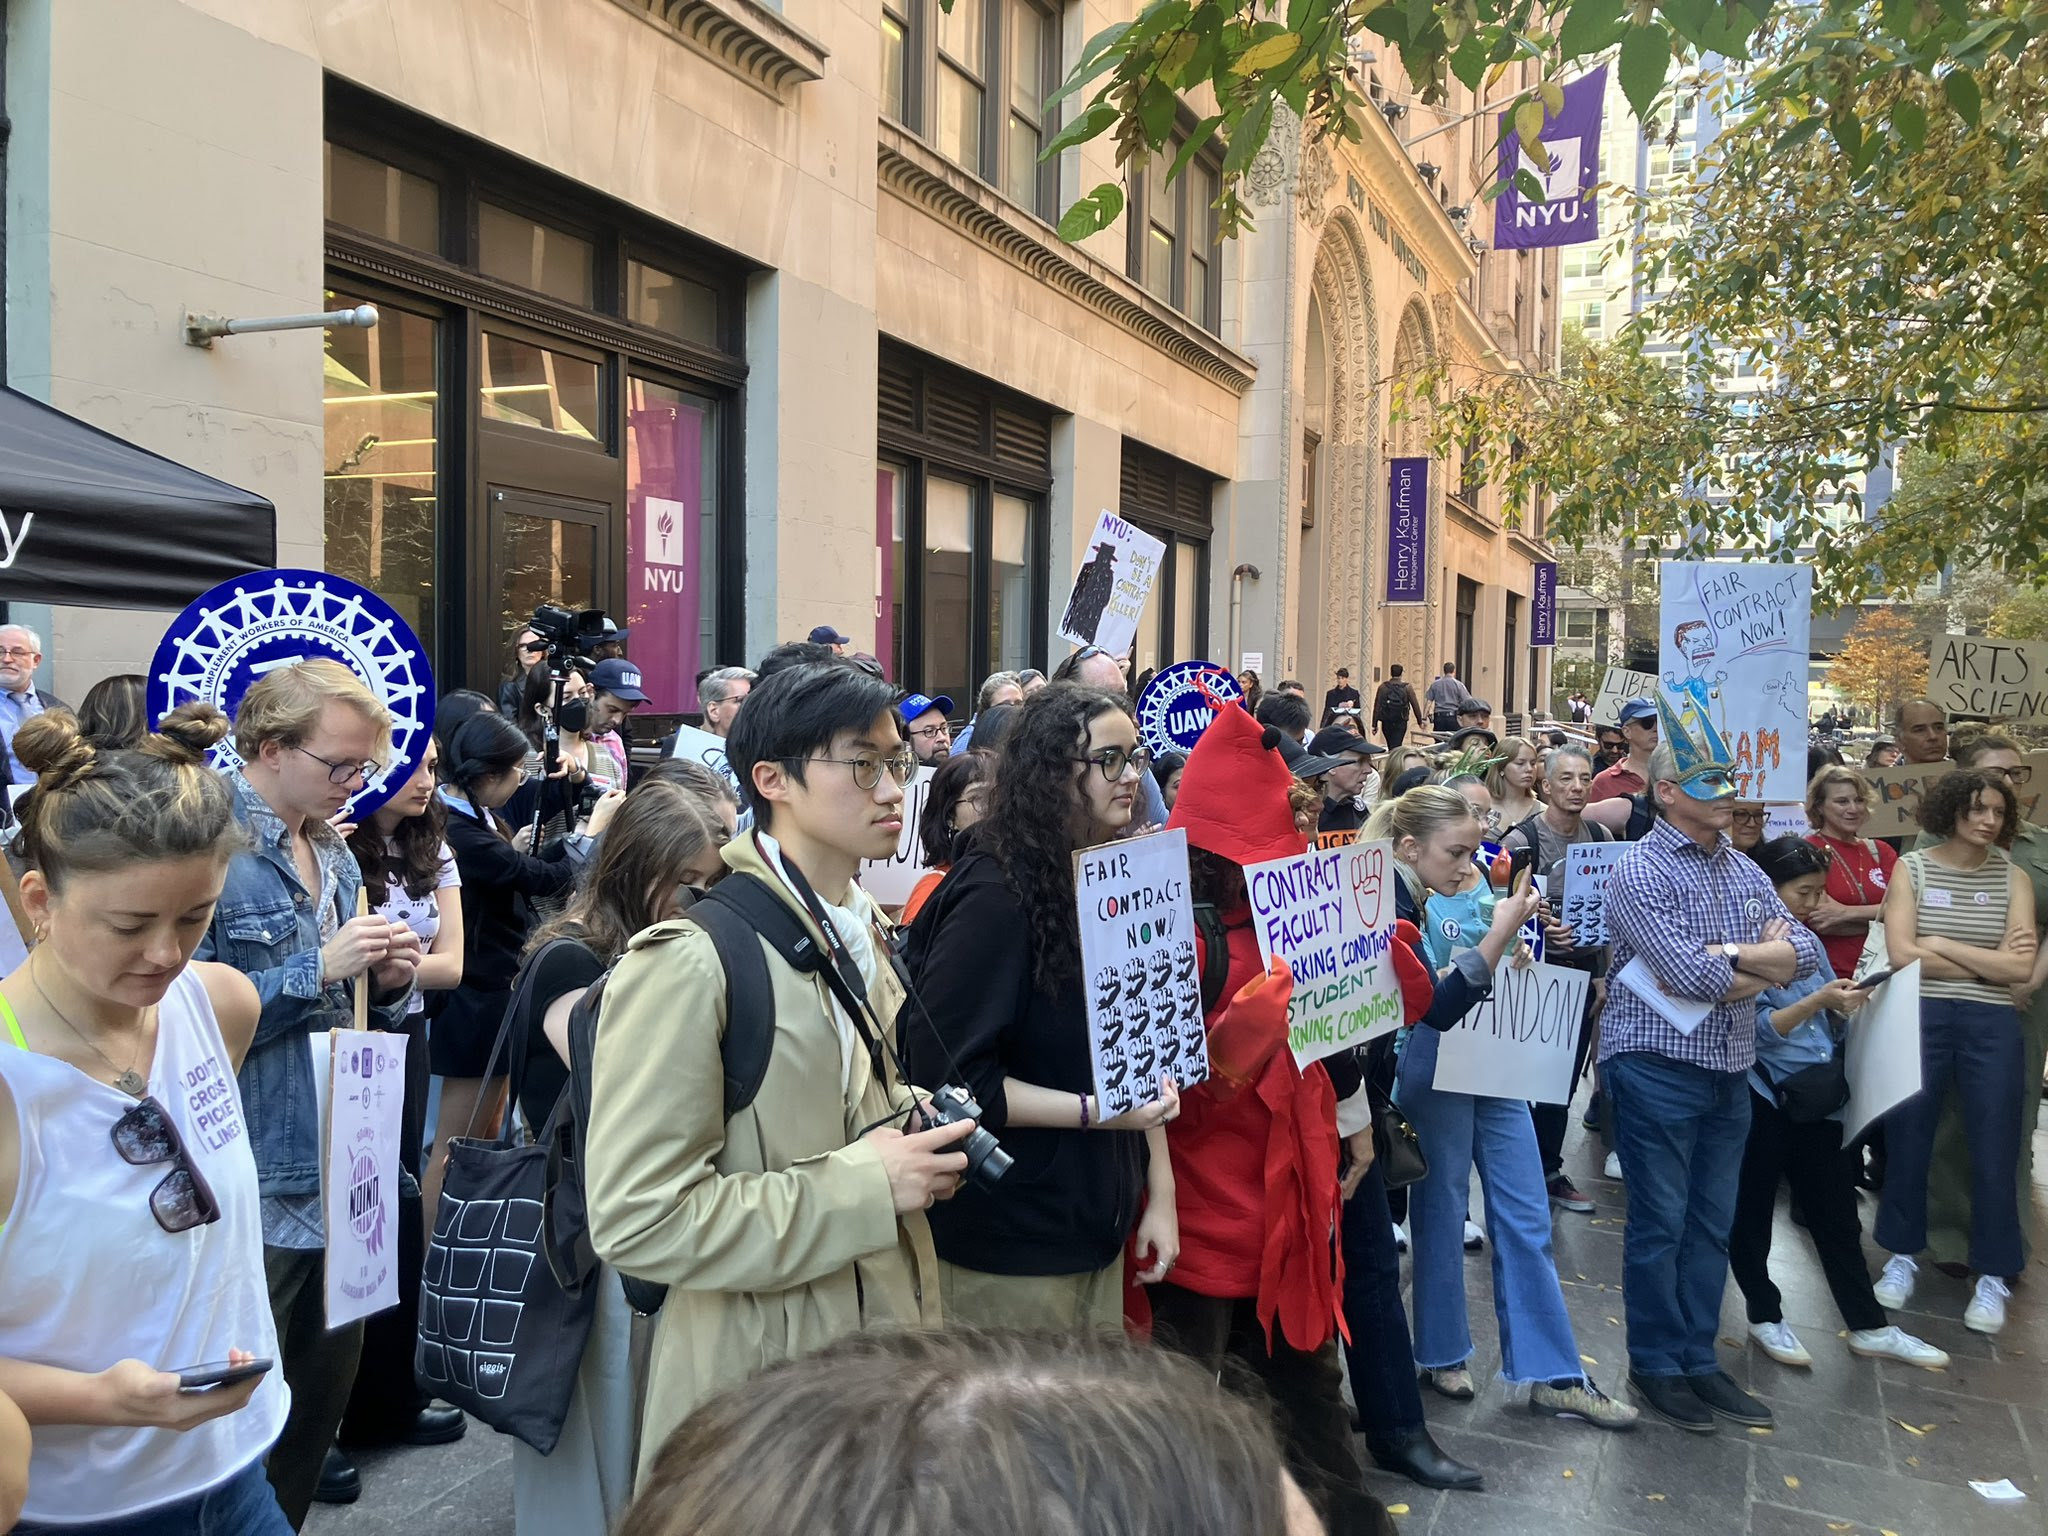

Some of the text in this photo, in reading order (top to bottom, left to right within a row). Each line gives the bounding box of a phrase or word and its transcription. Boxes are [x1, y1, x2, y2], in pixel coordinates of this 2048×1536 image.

[1516, 200, 1579, 228] NYU
[1101, 513, 1133, 542] NYU:
[1395, 467, 1412, 591] Henry Kaufman
[1410, 515, 1419, 590] Management Center
[644, 567, 684, 594] NYU
[1702, 571, 1747, 604] FAIR
[1714, 572, 1797, 630] CONTRACT
[1537, 567, 1548, 638] Henry Kaufman
[1740, 609, 1786, 648] NOW!
[205, 618, 350, 691] IMPLEMENT WORKERS OF AMERICA
[1936, 640, 2027, 685] ARTS
[1170, 707, 1213, 735] UAW
[1084, 853, 1131, 887] FAIR
[1573, 847, 1602, 859] FAIR
[1098, 879, 1182, 922] CONTRACT
[1252, 854, 1341, 926] CONTRACT
[821, 920, 840, 949] Canon
[1126, 909, 1177, 949] NOW!
[1266, 897, 1344, 955] FACULTY
[1287, 965, 1378, 1023] STUDENT
[1461, 967, 1582, 1050] ANDON
[208, 1119, 241, 1150] LINES
[349, 1174, 379, 1222] UNION
